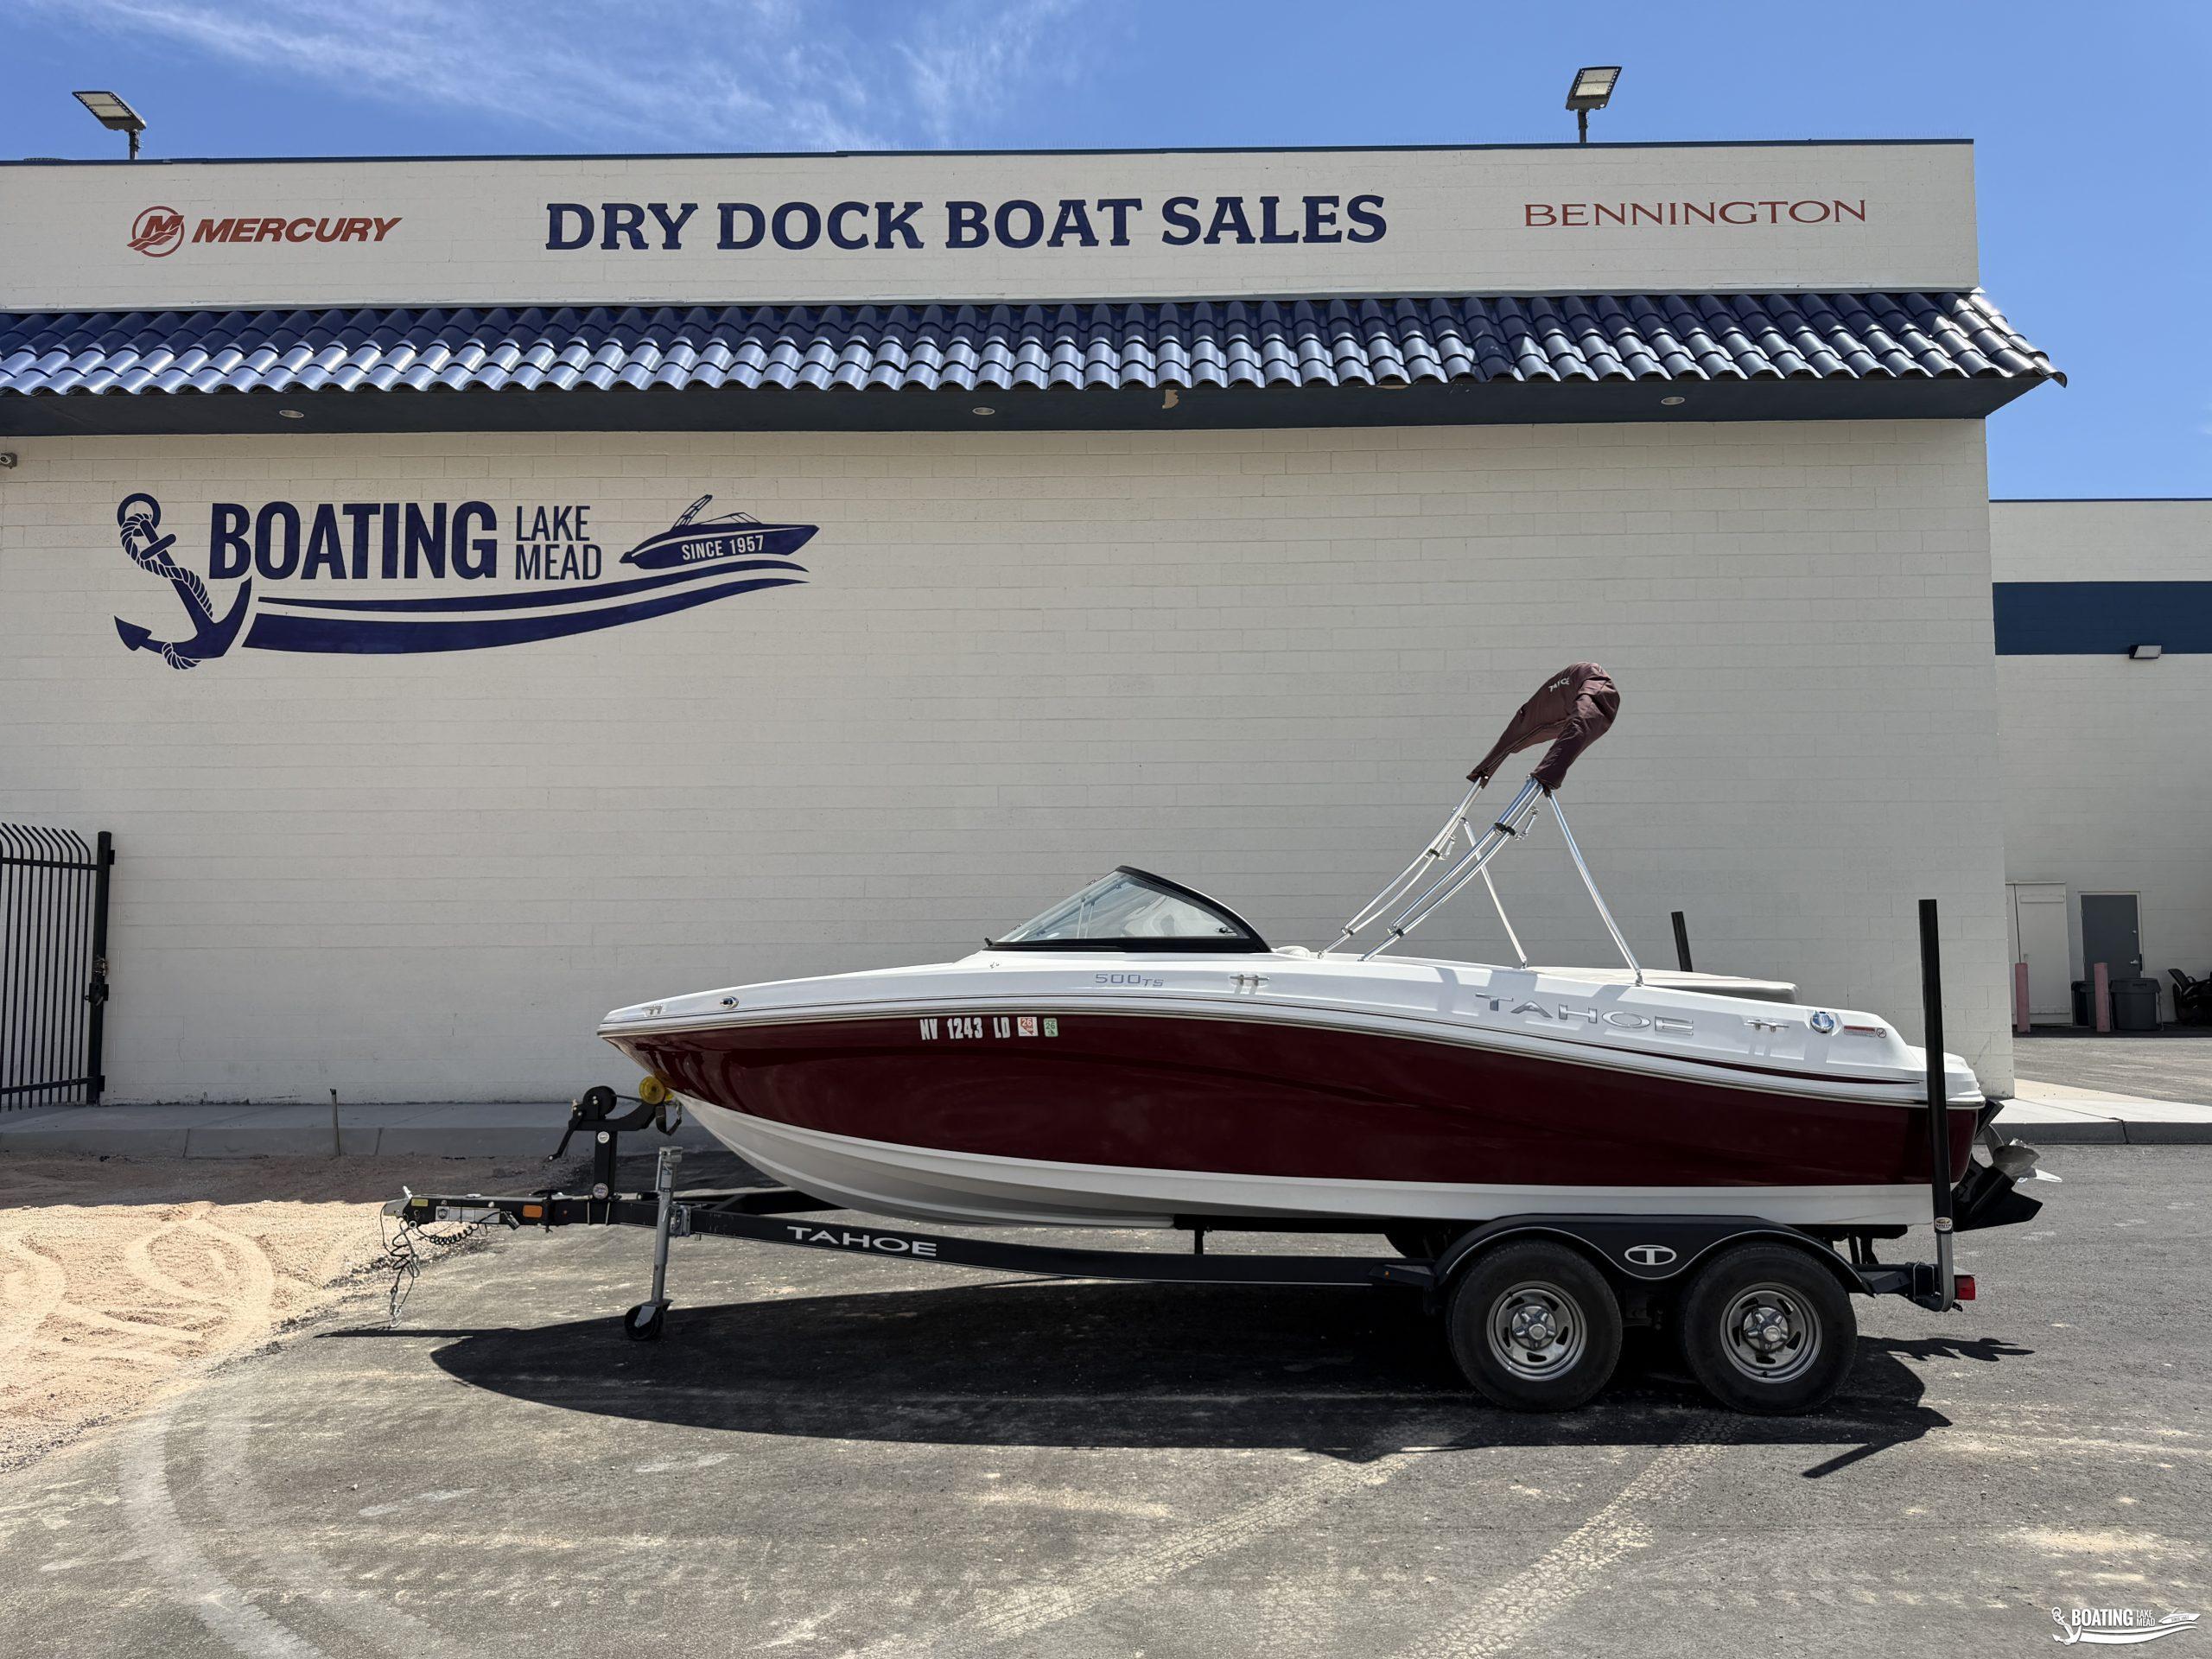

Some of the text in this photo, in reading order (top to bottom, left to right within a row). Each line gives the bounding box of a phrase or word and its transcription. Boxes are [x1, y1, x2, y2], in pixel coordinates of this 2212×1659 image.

[545, 195, 1387, 250] DRY DOCK BOAT SALES
[1524, 200, 1866, 226] BENNINGTON
[192, 217, 404, 243] MERCURY
[517, 505, 590, 541] LAKE
[209, 501, 498, 580] BOATING
[682, 535, 765, 561] SINCE 1957
[515, 544, 601, 580] MEAD
[919, 1017, 1011, 1040] NV 1243 LD
[1476, 994, 1694, 1036] TAHOE
[787, 1225, 937, 1256] TAHOE
